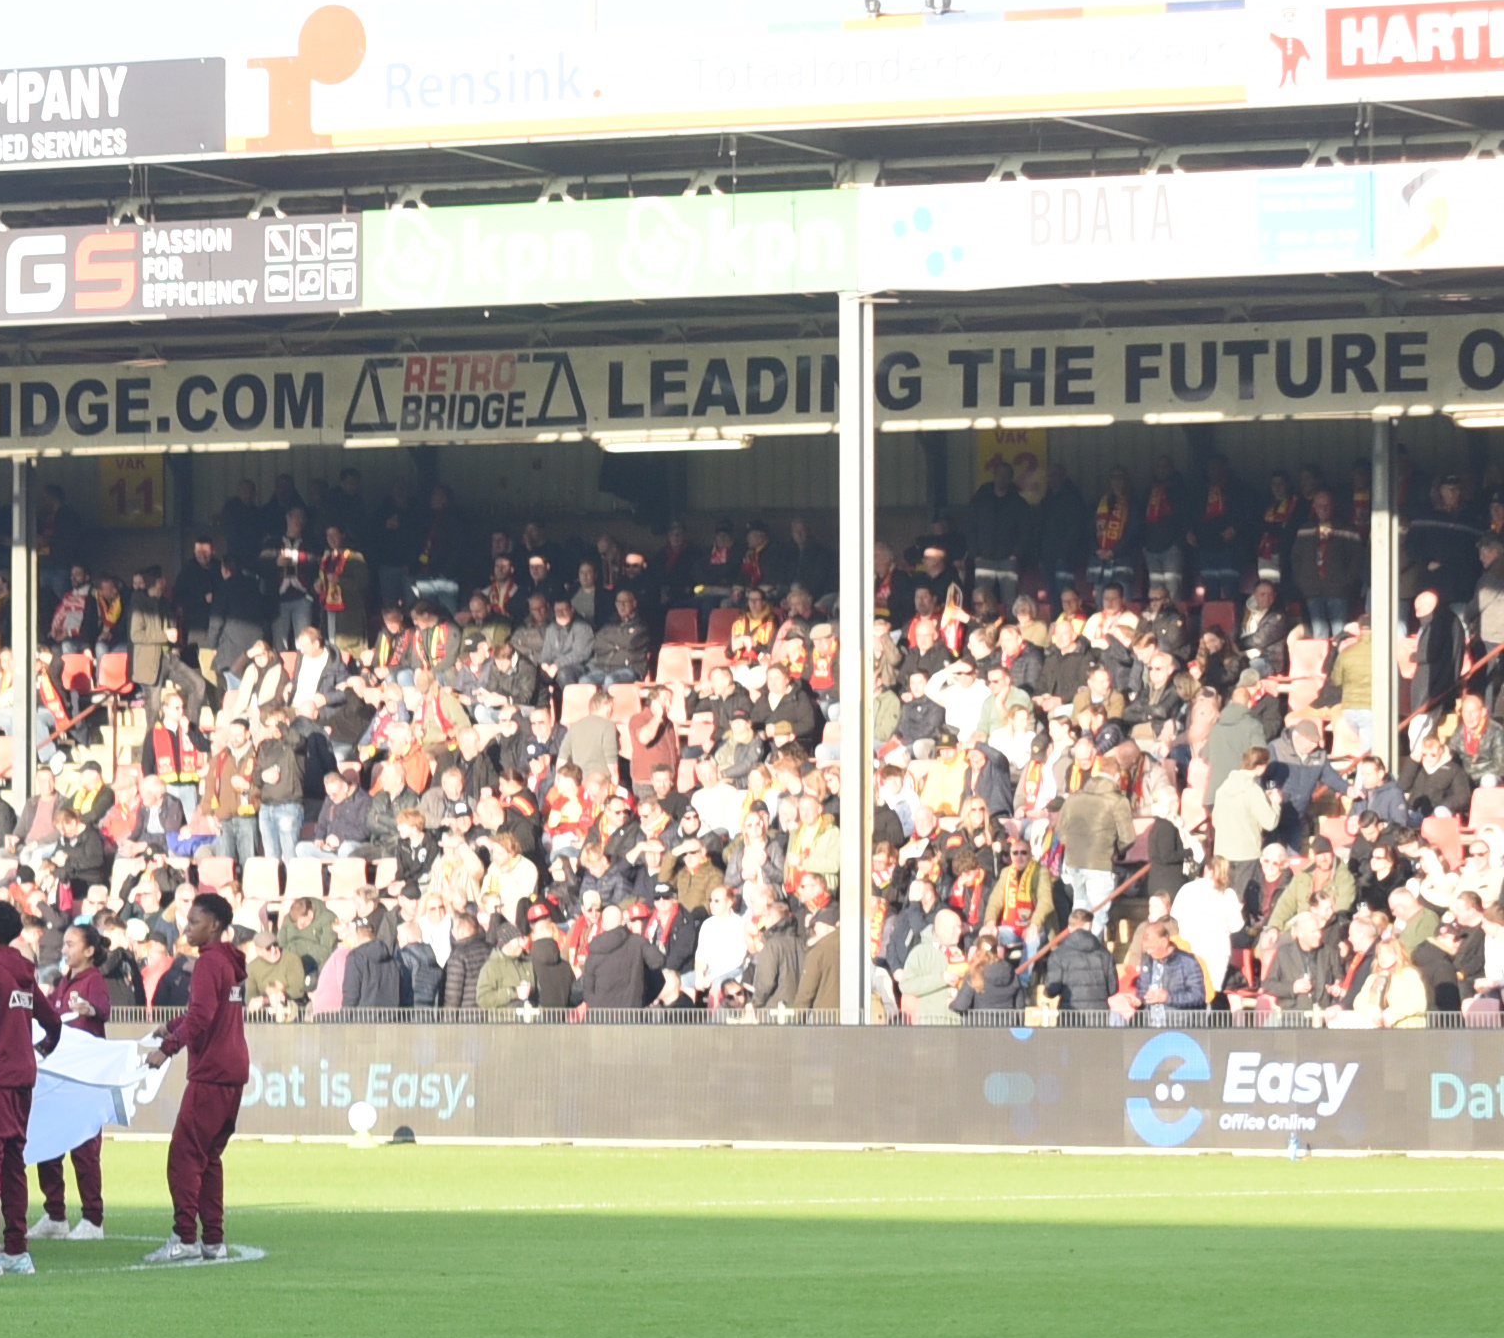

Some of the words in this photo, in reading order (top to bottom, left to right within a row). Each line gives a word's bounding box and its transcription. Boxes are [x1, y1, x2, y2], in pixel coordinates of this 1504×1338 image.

[31, 127, 128, 160] SERVICES
[142, 228, 232, 255] PASSION
[460, 218, 594, 295] kpn
[706, 205, 846, 290] kpn
[142, 257, 184, 281] FOR
[142, 279, 258, 308] EFFICIENCY
[403, 352, 518, 393] RETRO
[948, 345, 1096, 409] THE
[1124, 331, 1429, 405] FUTURE
[399, 390, 527, 432] BRIDGE
[108, 476, 156, 514] 11
[319, 1058, 352, 1108] is
[365, 1062, 476, 1120] Easy.
[1222, 1051, 1360, 1118] Easy
[1220, 1113, 1266, 1132] Office
[1268, 1114, 1317, 1132] Online
